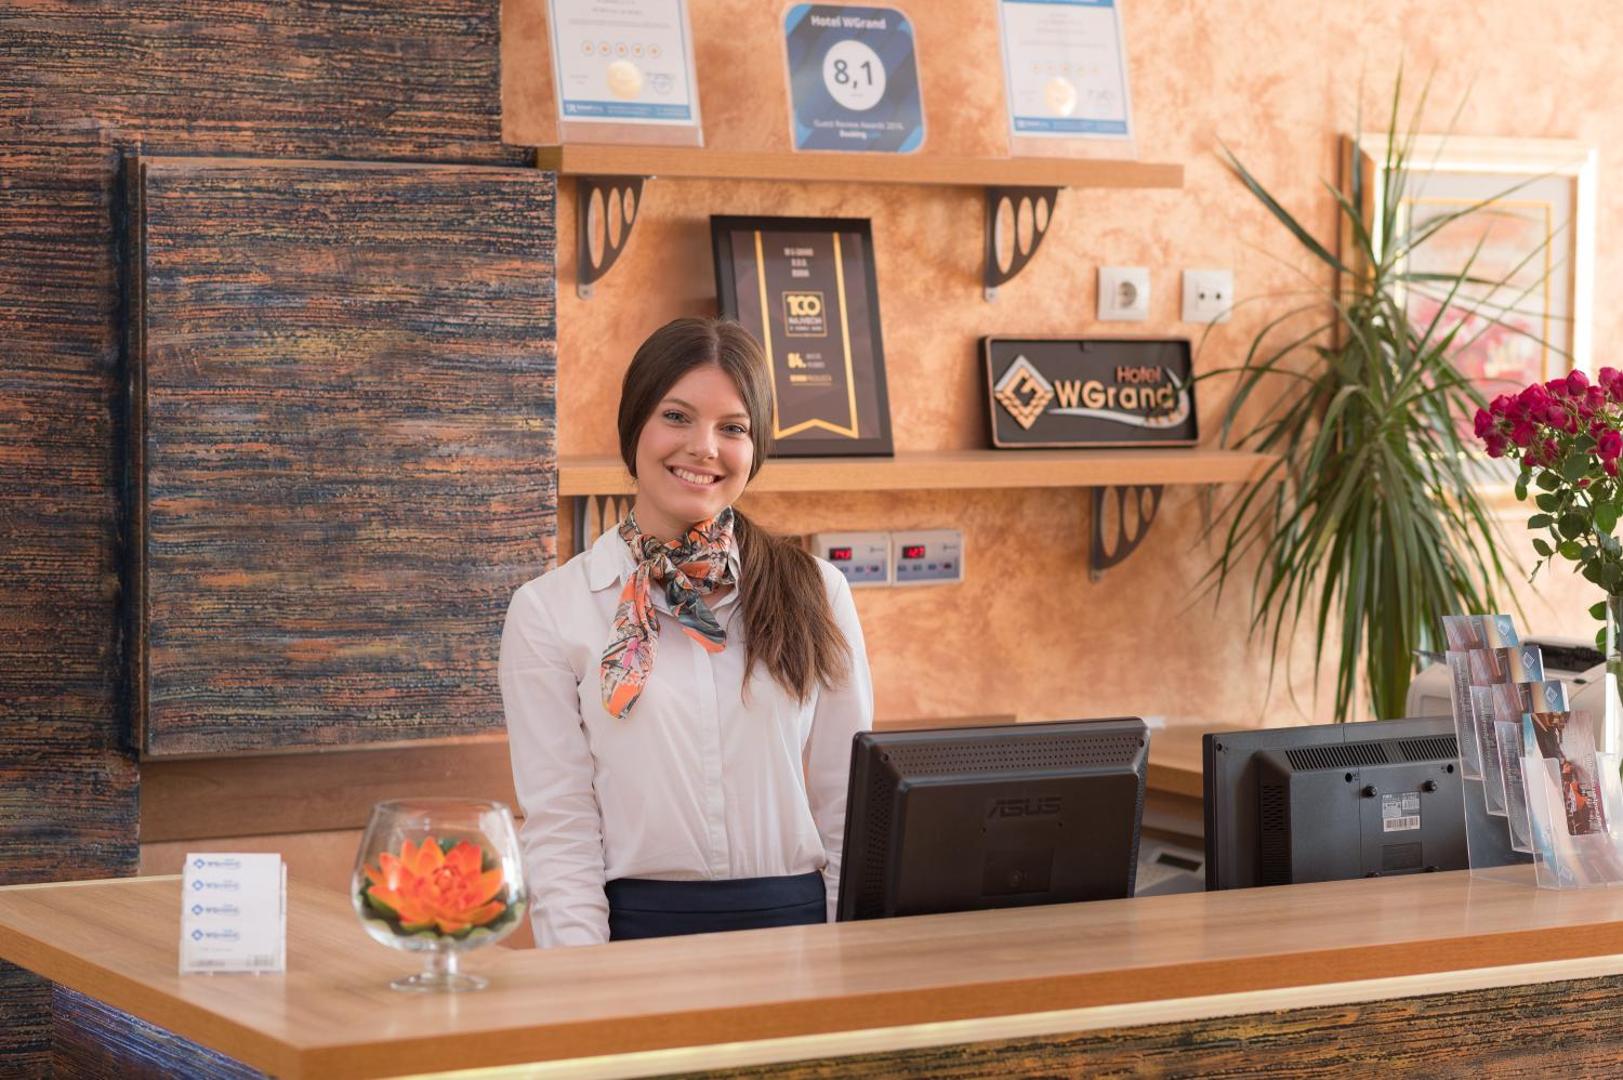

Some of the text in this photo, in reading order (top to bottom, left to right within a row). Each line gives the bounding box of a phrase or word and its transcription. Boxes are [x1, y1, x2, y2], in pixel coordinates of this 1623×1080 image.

[811, 15, 841, 27] Hotel
[833, 59, 873, 89] 8,1
[787, 296, 821, 316] 100
[1116, 365, 1161, 384] Hotel
[1054, 380, 1175, 409] WGrand
[987, 797, 1063, 819] ASUS
